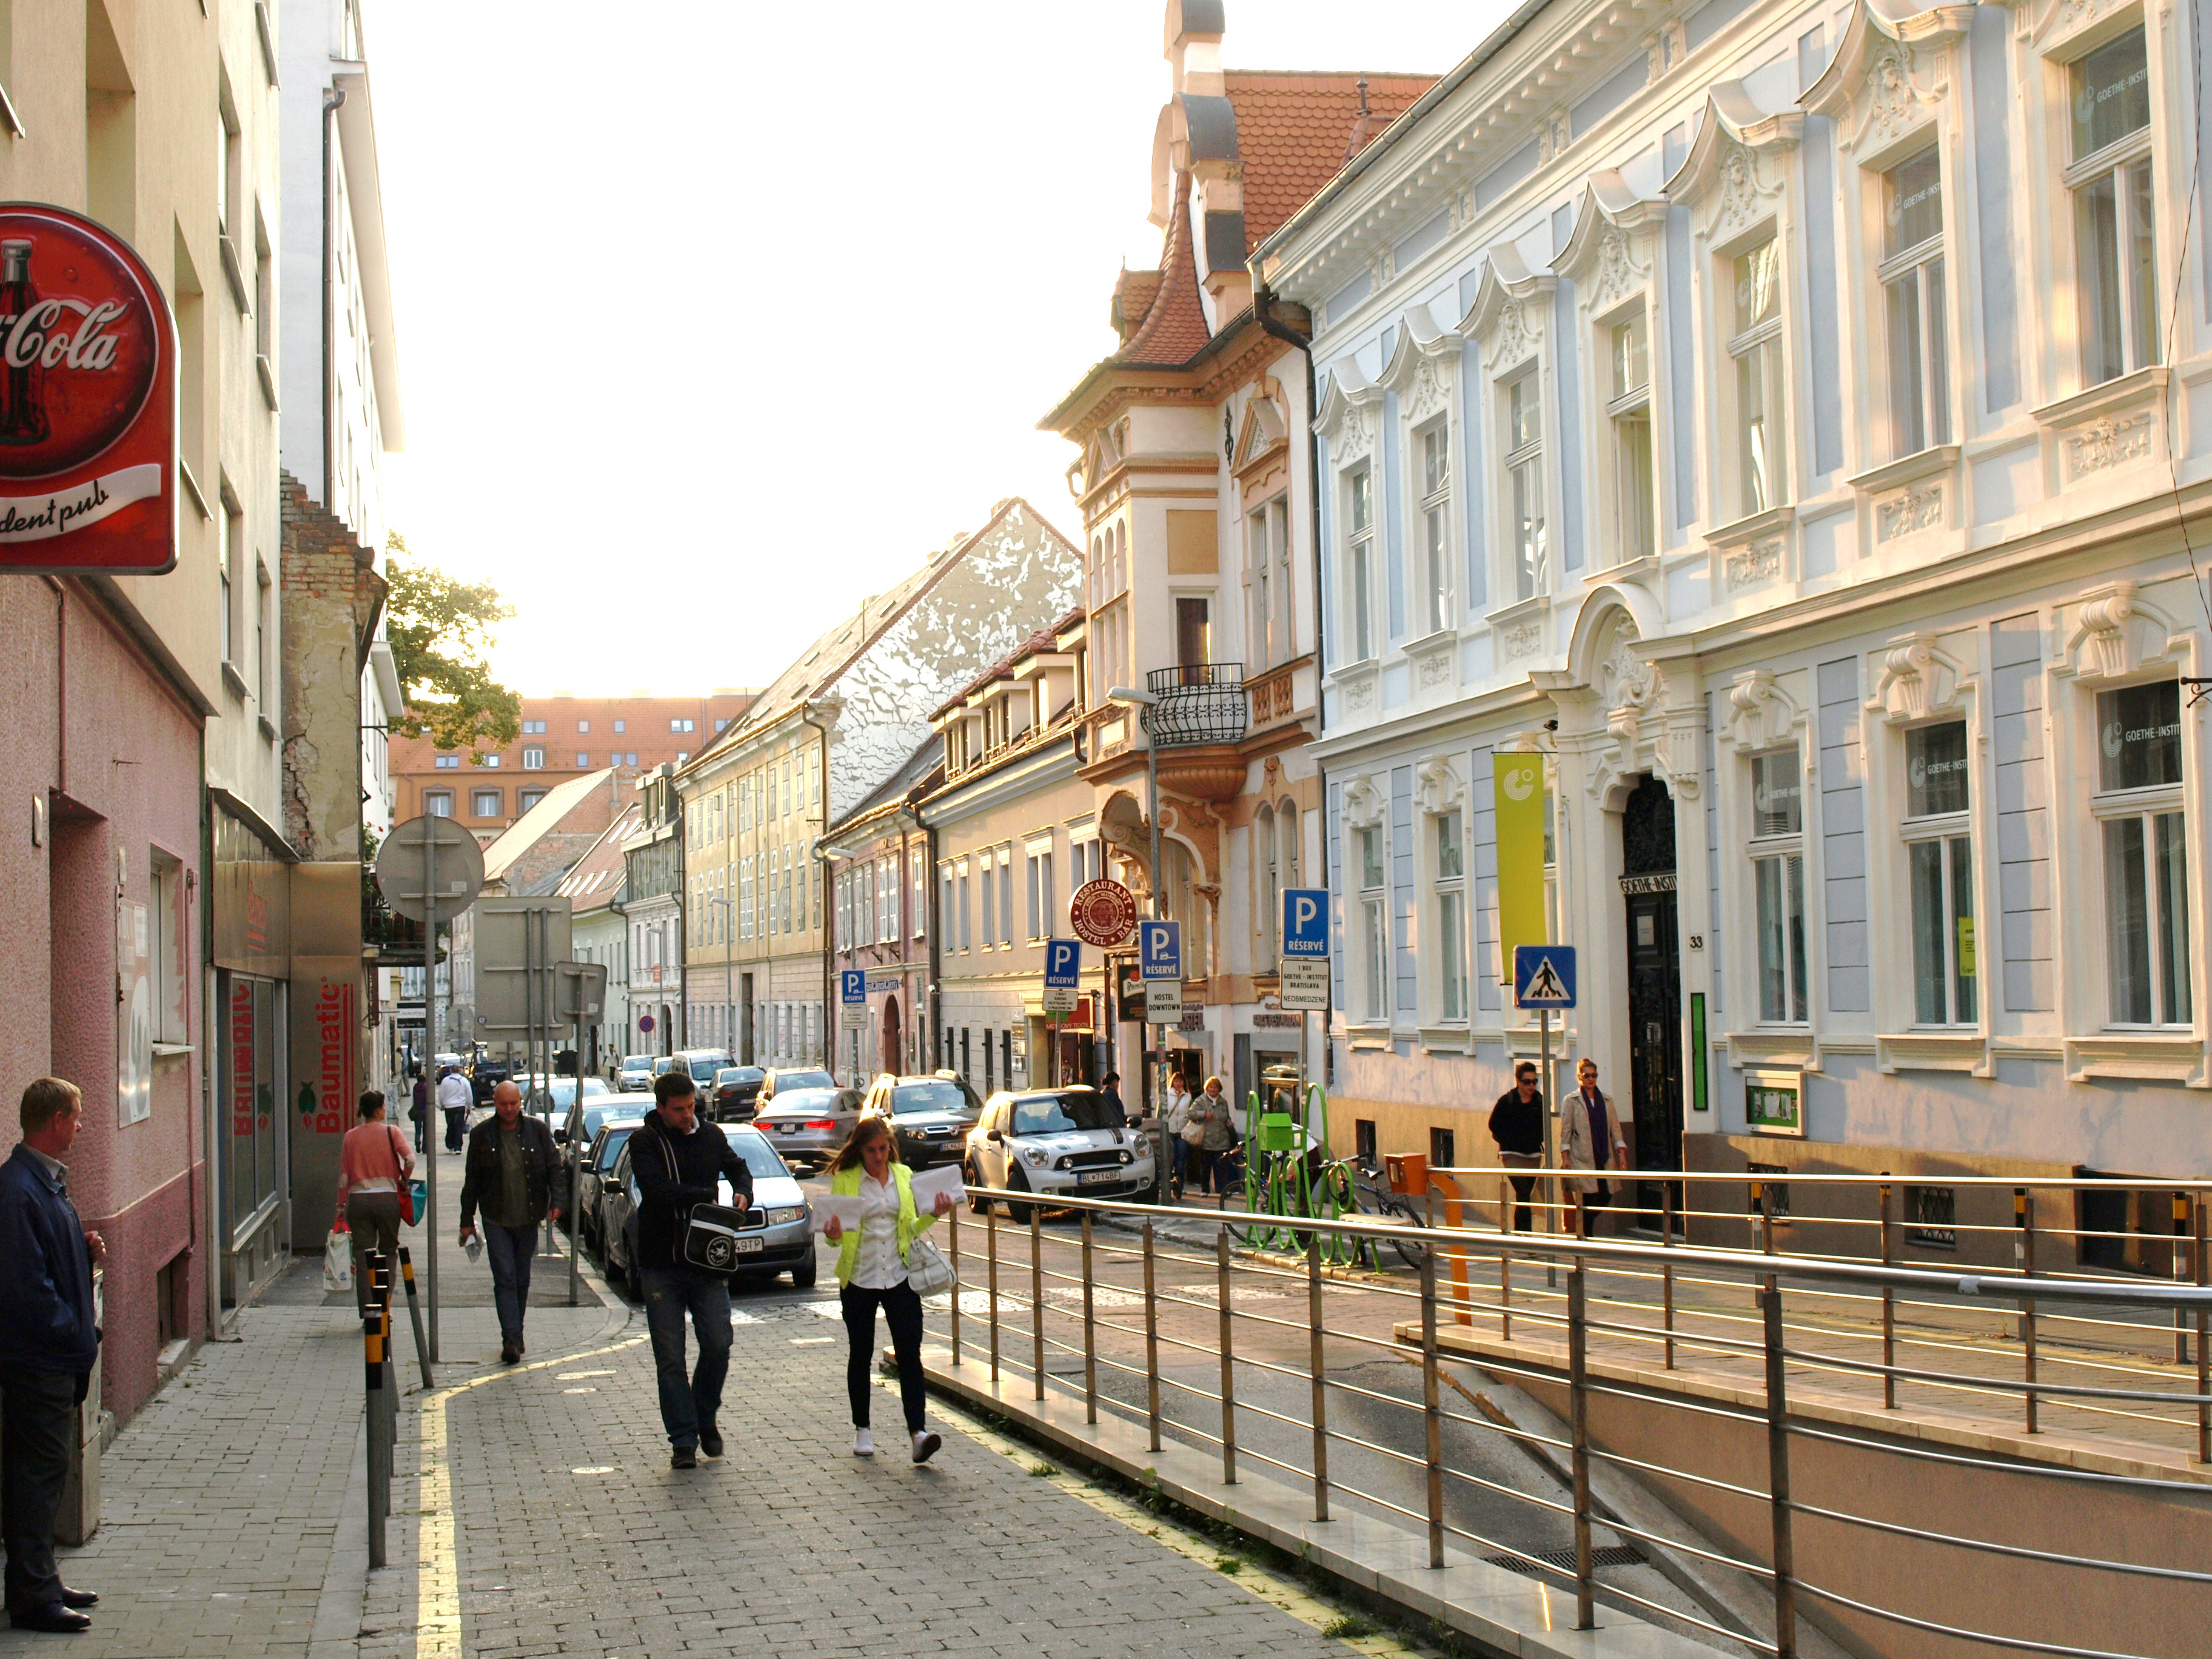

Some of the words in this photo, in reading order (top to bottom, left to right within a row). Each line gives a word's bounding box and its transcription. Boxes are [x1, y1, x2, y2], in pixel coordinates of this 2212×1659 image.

[0, 298, 129, 370] -Cola
[60, 479, 109, 532] pub
[1074, 881, 1132, 906] RESTAURANT
[1296, 897, 1316, 934] P
[1074, 919, 1106, 945] HOSTEL
[1117, 919, 1133, 939] BAR
[1151, 928, 1169, 960] P
[1289, 938, 1324, 951] RÉSERVÉ
[1690, 936, 1703, 948] 33
[1054, 945, 1071, 973] P
[1145, 964, 1176, 974] RÉSERVÉ
[848, 974, 859, 993] P
[1048, 974, 1075, 984] RÉSERVÉ
[315, 984, 341, 1133] Baumatic
